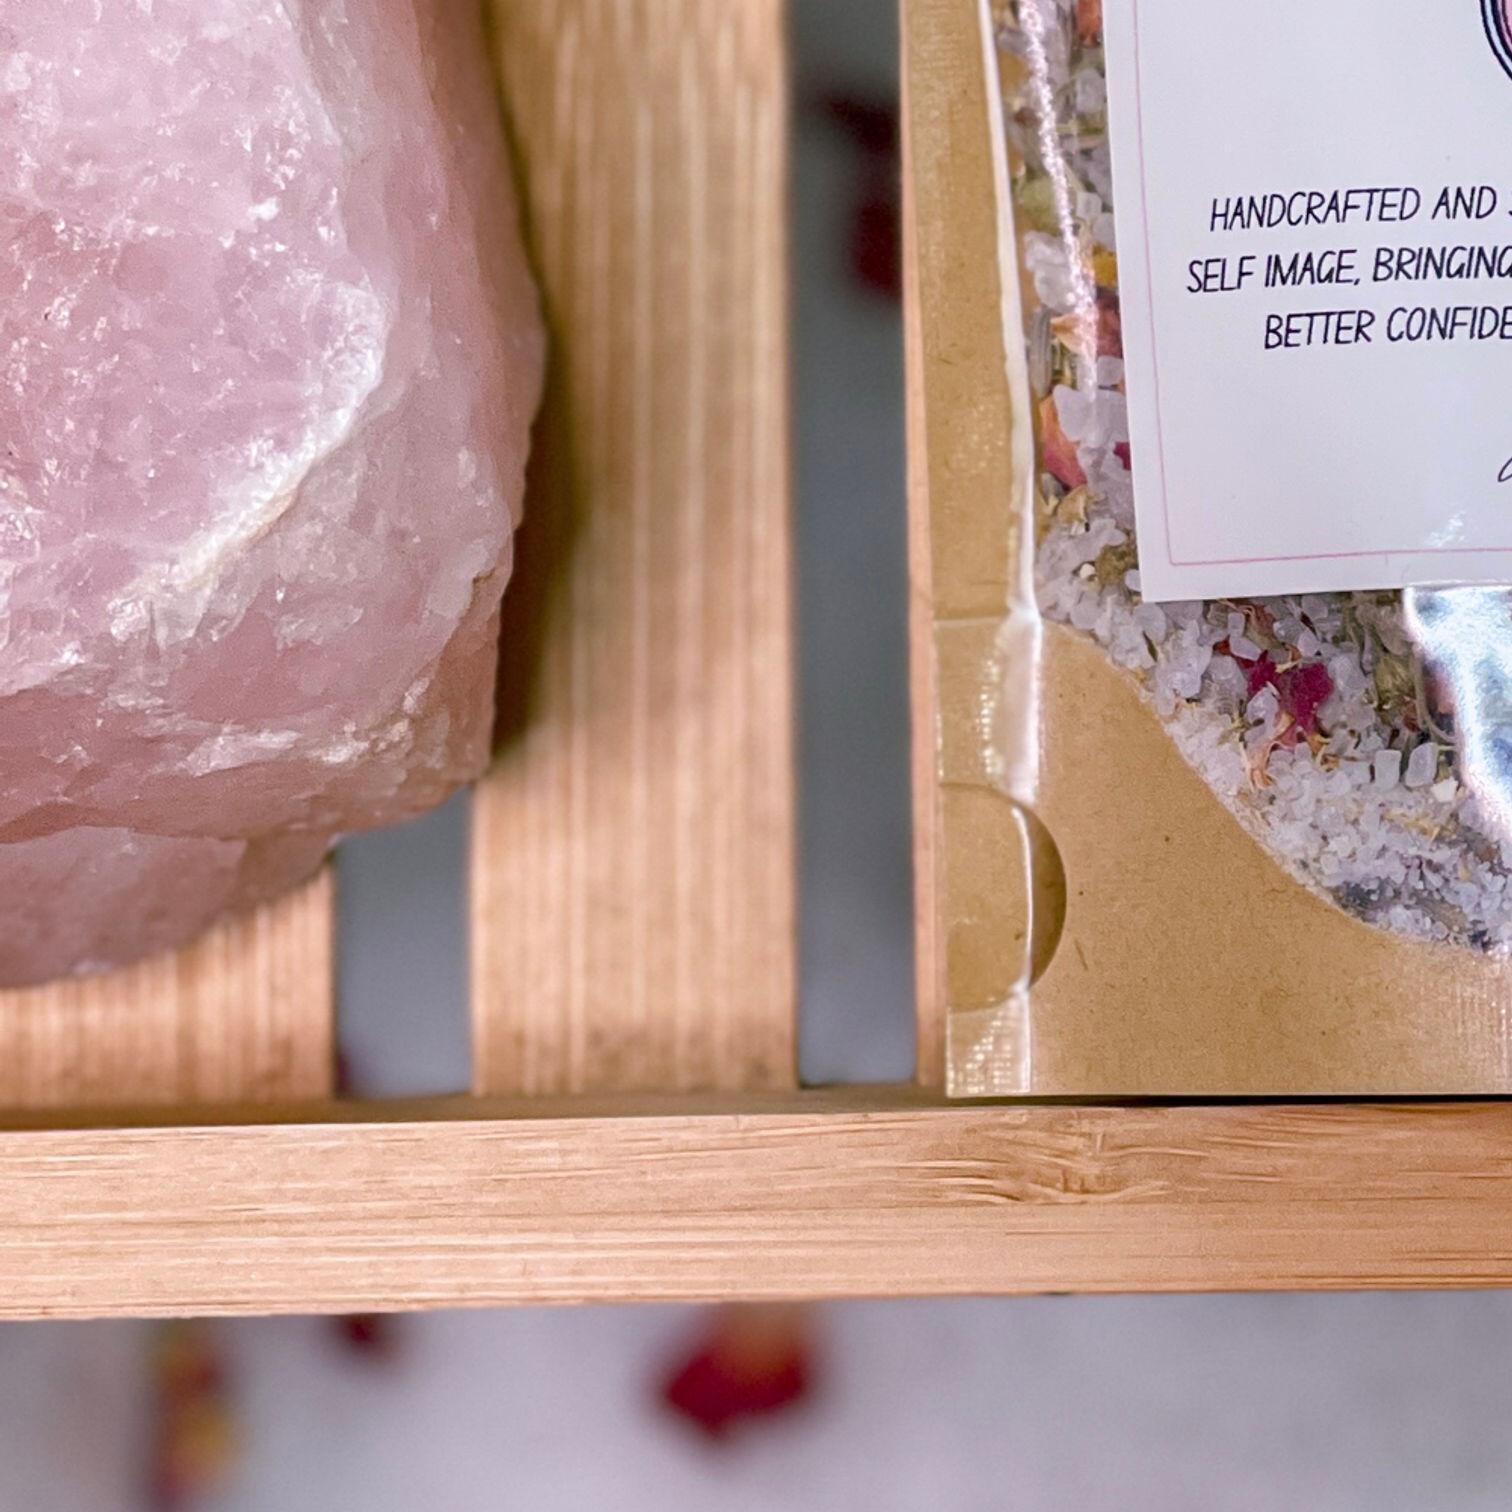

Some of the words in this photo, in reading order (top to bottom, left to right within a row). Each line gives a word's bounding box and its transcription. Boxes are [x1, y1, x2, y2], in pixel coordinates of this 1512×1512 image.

[1210, 185, 1420, 230] HANDCRAFTED
[1432, 186, 1497, 220] AND
[1187, 254, 1255, 293] SELF
[1265, 249, 1360, 288] IMAGE,
[1264, 310, 1375, 350] BETTER
